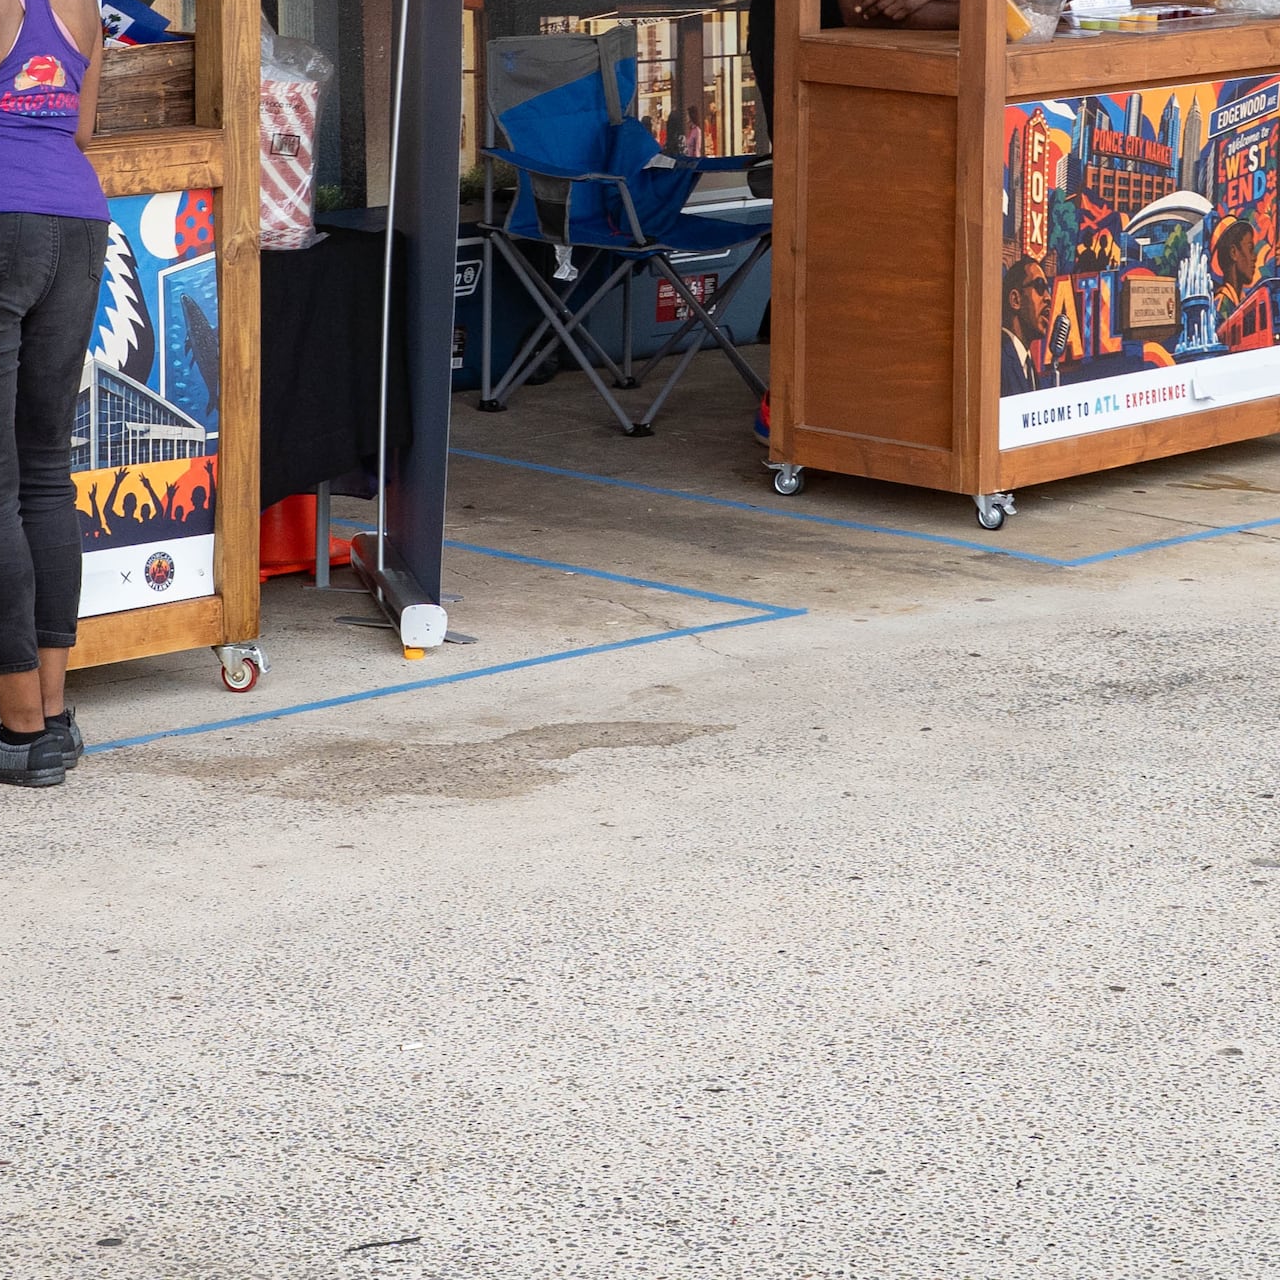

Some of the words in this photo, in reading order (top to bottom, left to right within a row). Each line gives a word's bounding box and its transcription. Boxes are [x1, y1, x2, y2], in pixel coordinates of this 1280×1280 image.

[1217, 94, 1267, 130] EDGEWOOD
[1267, 94, 1278, 107] AVE
[1093, 128, 1123, 154] PONCE
[1125, 135, 1145, 158] CITY
[1145, 139, 1174, 166] MARKET
[1225, 139, 1269, 180] WEST
[1227, 131, 1261, 156] Welcome
[1261, 126, 1271, 139] to
[1031, 131, 1045, 245] FOX
[1227, 170, 1267, 208] END
[1043, 272, 1122, 365] ATL
[1022, 405, 1072, 429] WELCOME
[1077, 401, 1089, 418] TO
[1094, 394, 1120, 415] ATL
[1126, 383, 1187, 409] EXPERIENCE
